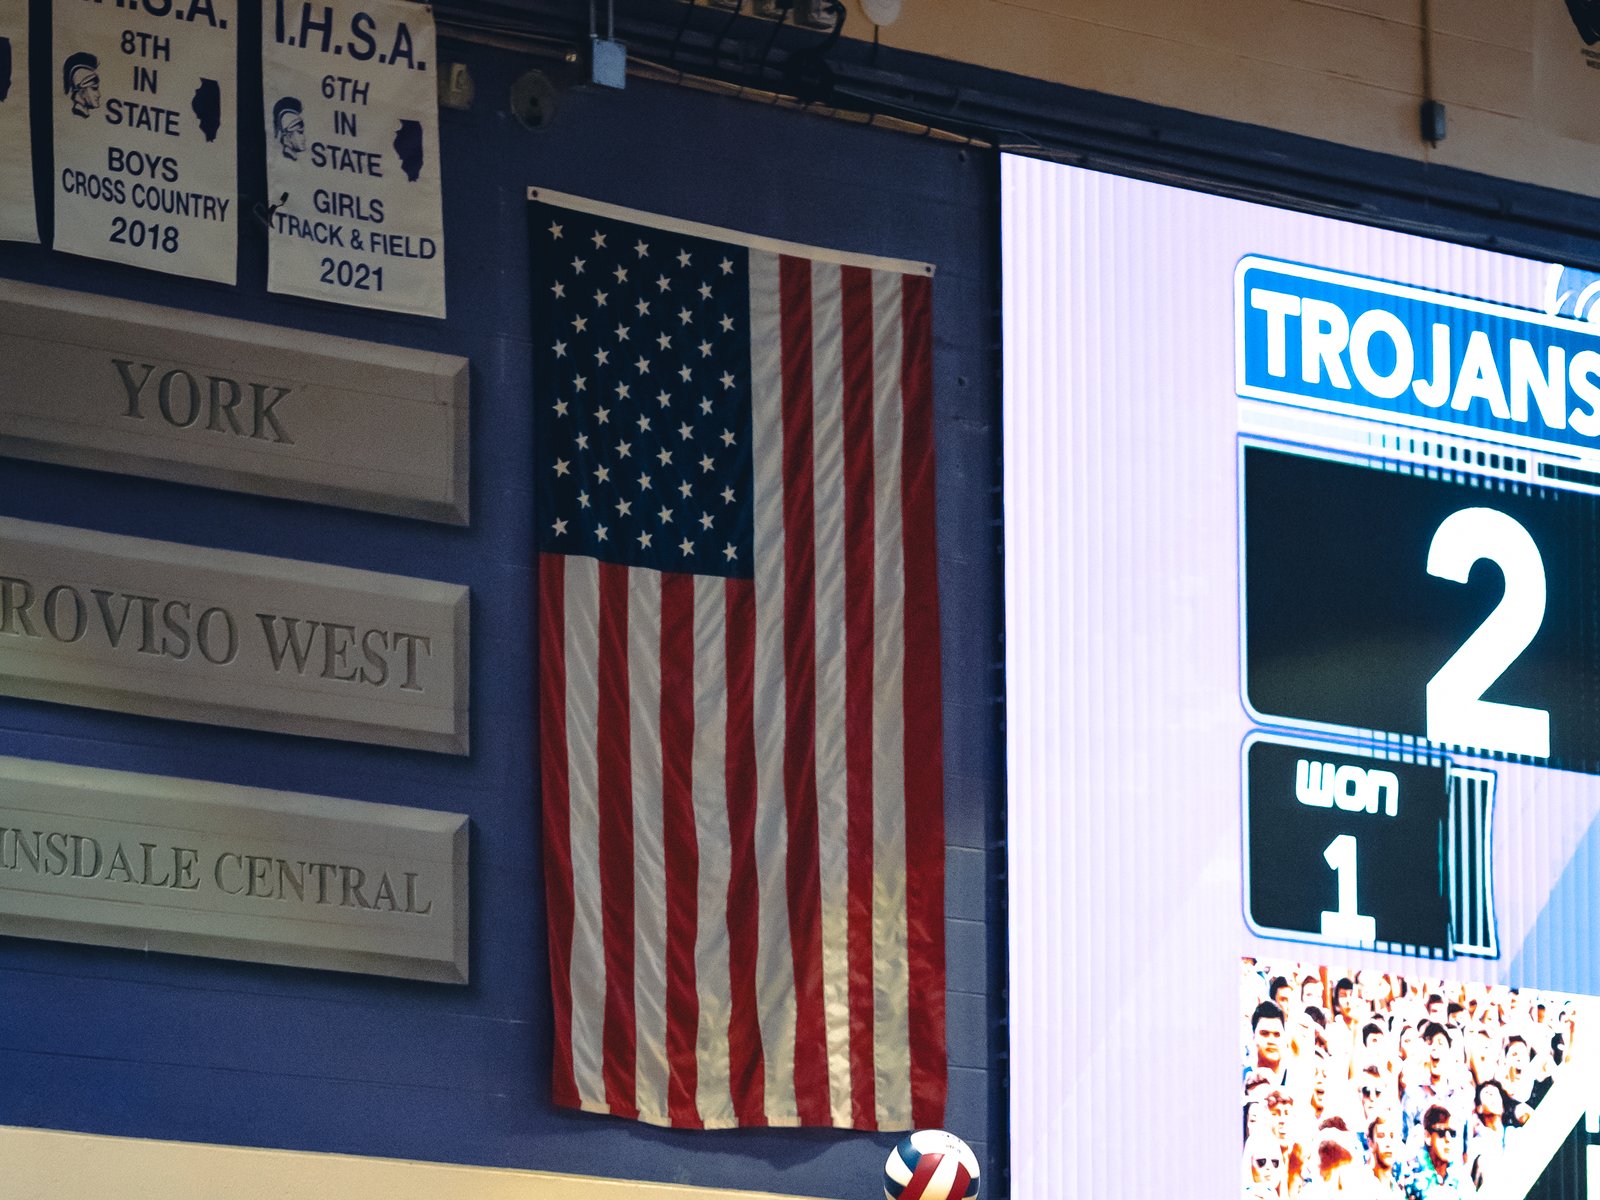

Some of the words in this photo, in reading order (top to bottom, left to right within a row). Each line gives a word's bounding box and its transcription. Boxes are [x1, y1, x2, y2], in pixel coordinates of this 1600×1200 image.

[121, 30, 170, 62] 8TH
[276, 0, 427, 71] I.H.S.A.
[133, 66, 157, 94] IN
[321, 75, 370, 105] 6TH
[105, 98, 180, 136] STATE
[334, 110, 357, 137] IN
[108, 147, 178, 182] BOYS
[311, 142, 383, 177] STATE
[62, 168, 126, 204] CROSS
[132, 183, 230, 222] COUNTRY
[313, 189, 384, 223] GIRLS
[109, 216, 179, 253] 2018
[276, 212, 344, 247] TRACK
[350, 229, 364, 250] &
[370, 232, 436, 259] FIELD
[320, 257, 383, 291] 2021
[1251, 287, 1600, 438] TROJANS
[112, 359, 295, 446] YORK
[0, 576, 240, 666] ROVISO
[255, 612, 432, 692] WEST
[1426, 506, 1550, 758] 2
[214, 851, 432, 915] CENTRAL
[1321, 834, 1376, 943] 1
